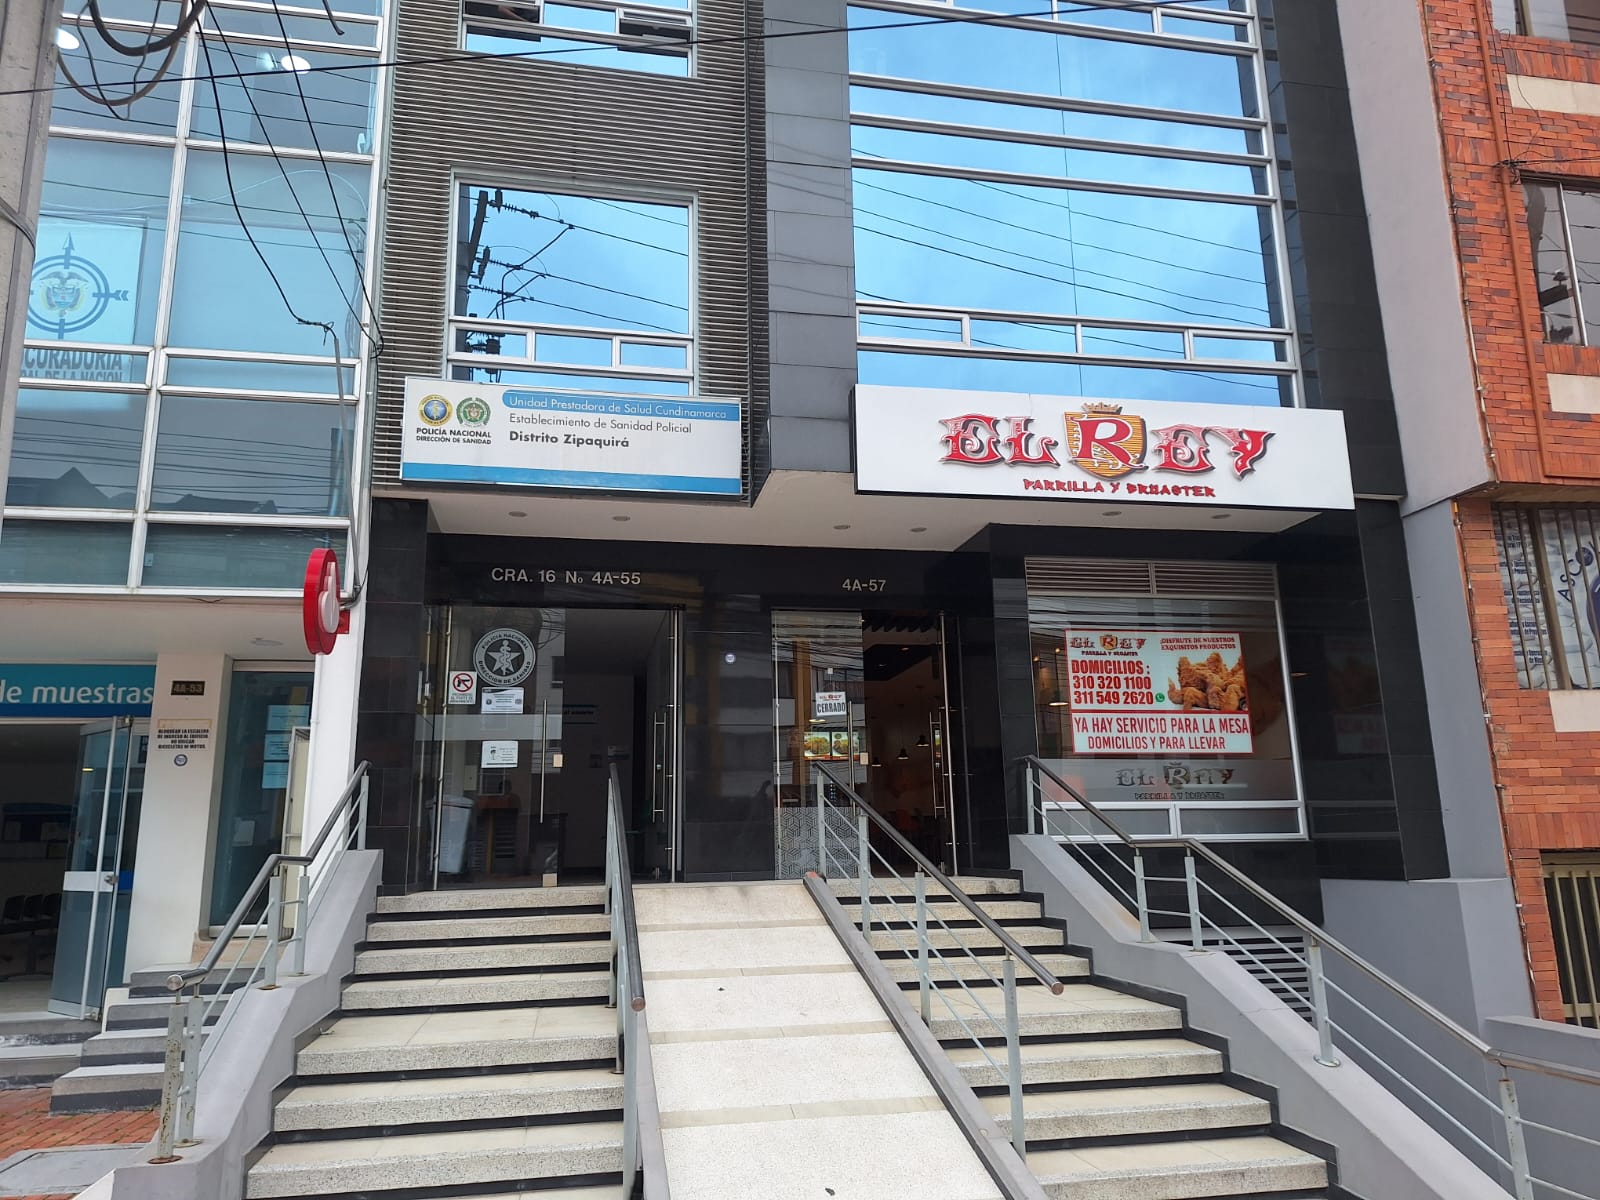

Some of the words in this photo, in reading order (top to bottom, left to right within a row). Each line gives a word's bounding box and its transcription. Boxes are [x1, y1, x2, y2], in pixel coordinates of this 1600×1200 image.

[509, 396, 548, 408] Unidad
[551, 399, 606, 412] Prestadora
[608, 404, 621, 413] de
[624, 404, 652, 415] Salud
[655, 405, 727, 418] Cundinamarca
[509, 413, 591, 428] Establecimiento
[594, 419, 607, 428] de
[610, 419, 653, 431] Sanidad
[656, 422, 692, 433] Policial
[416, 427, 447, 436] POLICÍA
[449, 430, 492, 438] NACIONAL
[416, 435, 451, 443] DIRECCIÓN
[509, 431, 559, 443] Distrito
[563, 434, 630, 449] Zipaquirá
[938, 413, 1061, 468] EL
[1066, 413, 1276, 482] REY
[1023, 478, 1103, 494] PARRILLA
[1111, 481, 1120, 494] Y
[491, 568, 533, 582] CRA.
[538, 569, 556, 583] 16
[591, 571, 642, 585] 4A-55
[842, 578, 887, 592] 4A-57
[1073, 675, 1095, 689] 310
[1097, 675, 1122, 690] 320
[1124, 676, 1152, 690] 1100
[32, 683, 154, 703] muestras
[1074, 690, 1094, 704] 311
[1096, 691, 1120, 704] 549
[1122, 691, 1154, 705] 2620
[817, 702, 846, 714] CERRADO
[1074, 717, 1088, 733] YA
[1092, 717, 1113, 733] HAY
[1117, 717, 1167, 734] SERVICIO
[1171, 717, 1199, 733] PARA
[1203, 717, 1216, 733] LA
[1219, 717, 1249, 734] MESA
[1088, 736, 1148, 750] DOMICILIOS
[1150, 736, 1157, 750] Y
[1159, 736, 1186, 749] PARA
[1188, 736, 1226, 750] LLEVAR
